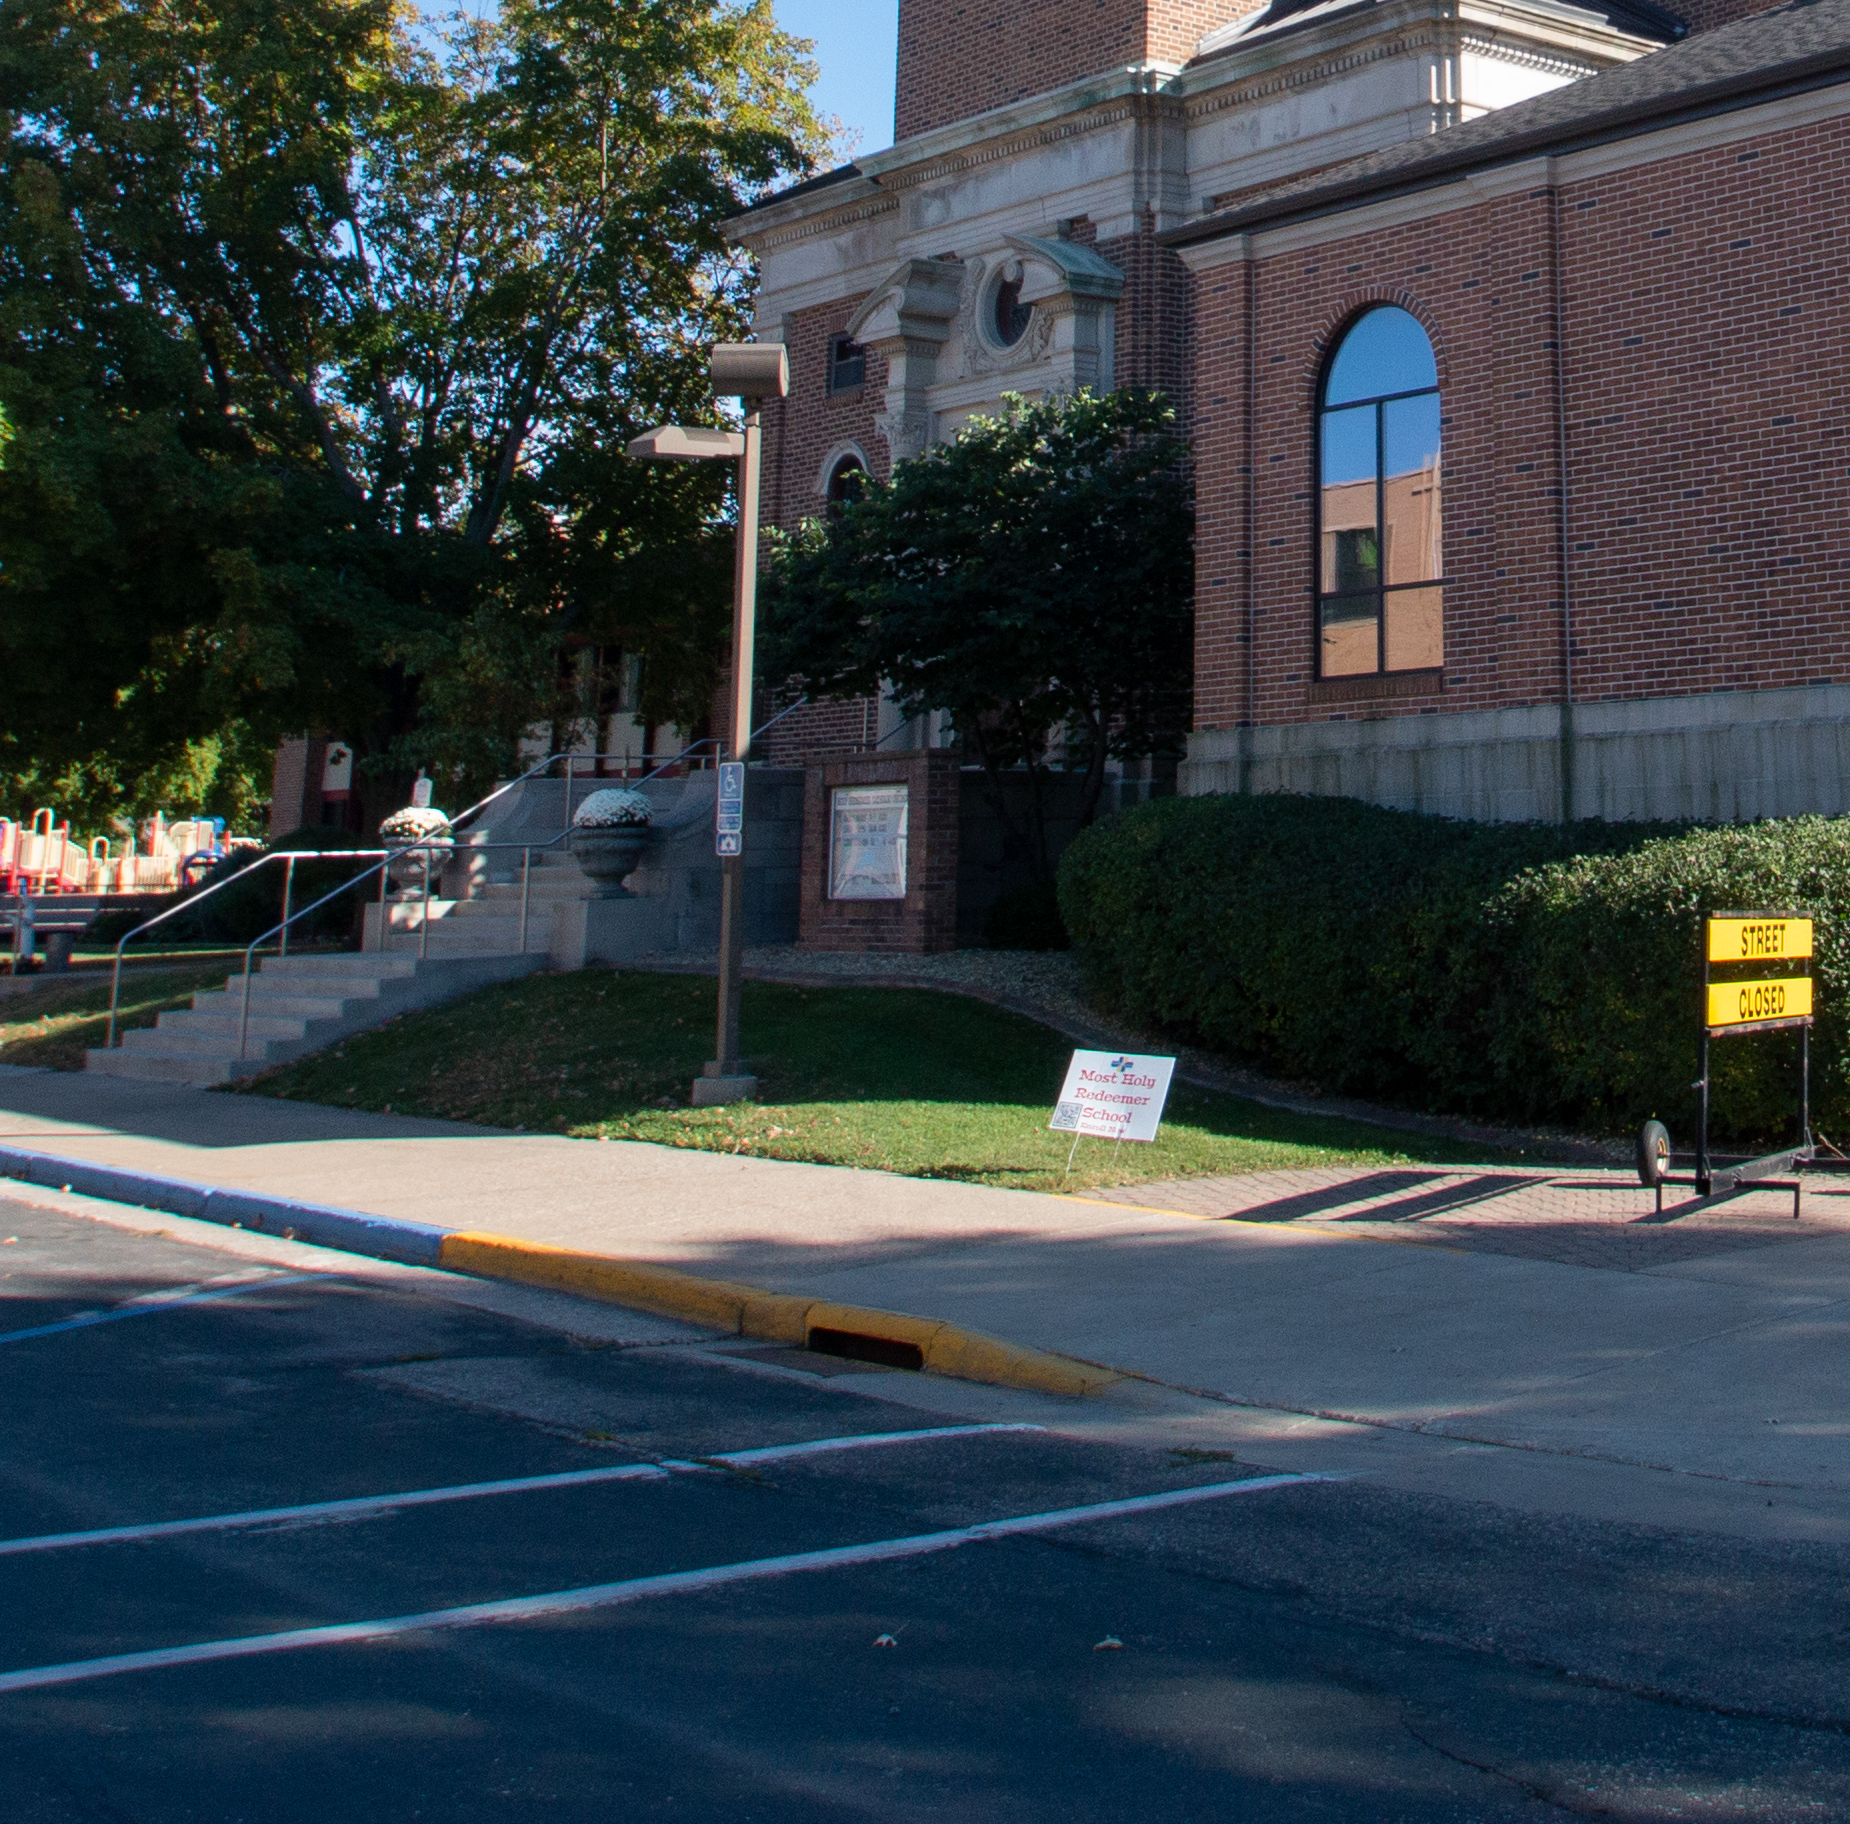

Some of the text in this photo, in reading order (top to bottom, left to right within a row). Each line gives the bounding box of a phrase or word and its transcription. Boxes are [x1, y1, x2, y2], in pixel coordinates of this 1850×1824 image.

[1741, 924, 1785, 956] STREET
[1739, 986, 1785, 1019] CLOSED
[1079, 1069, 1156, 1088] Most Holy
[1075, 1087, 1150, 1105] Redeemer
[1082, 1107, 1131, 1123] School
